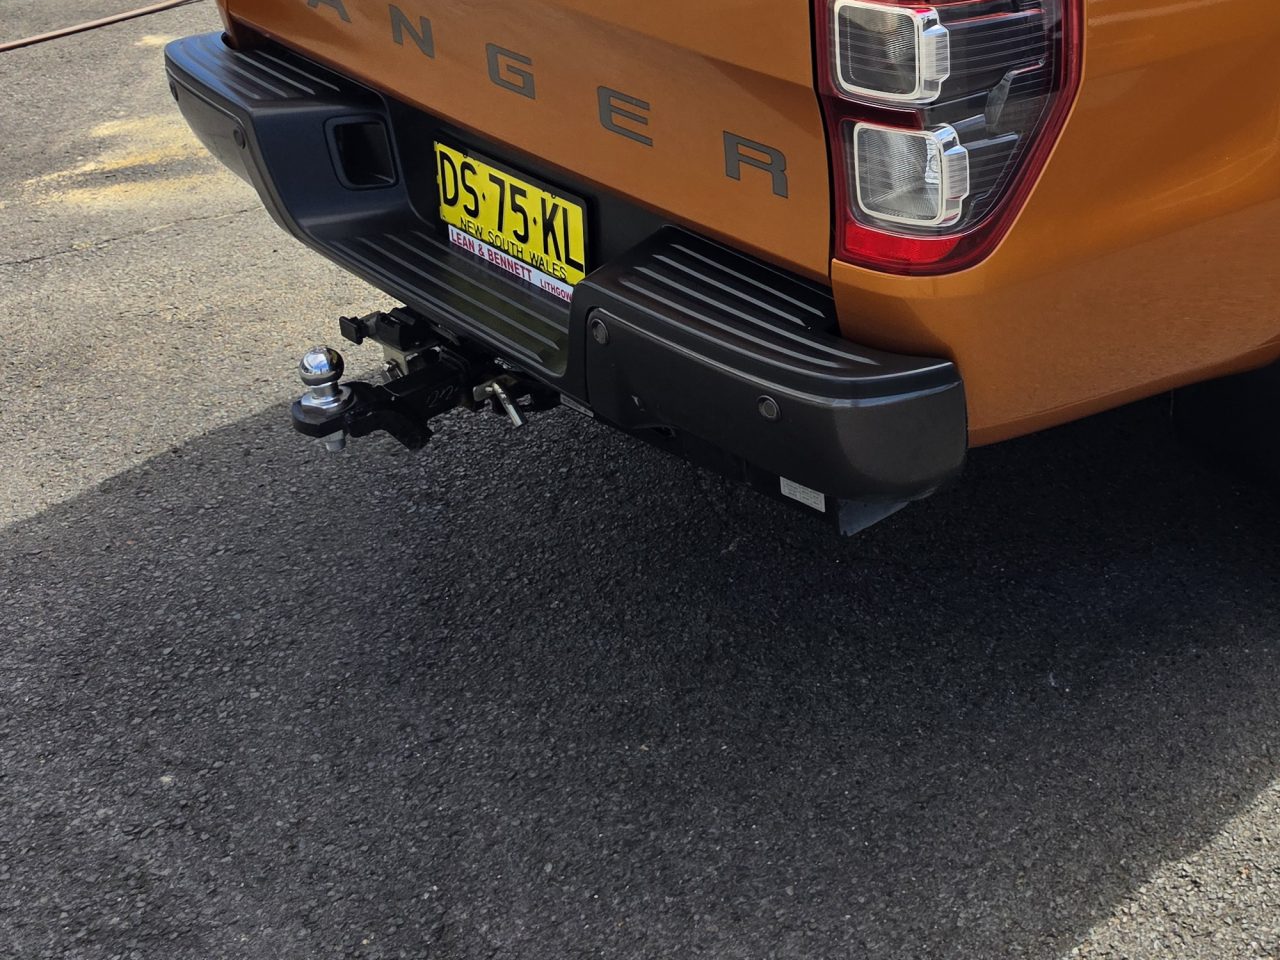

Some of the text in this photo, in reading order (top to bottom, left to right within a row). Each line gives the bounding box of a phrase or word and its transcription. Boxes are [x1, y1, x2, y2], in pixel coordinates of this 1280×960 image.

[451, 229, 573, 300] LEAN & BENNETT LITHGOW
[460, 217, 568, 280] NEW SOUTH WALES
